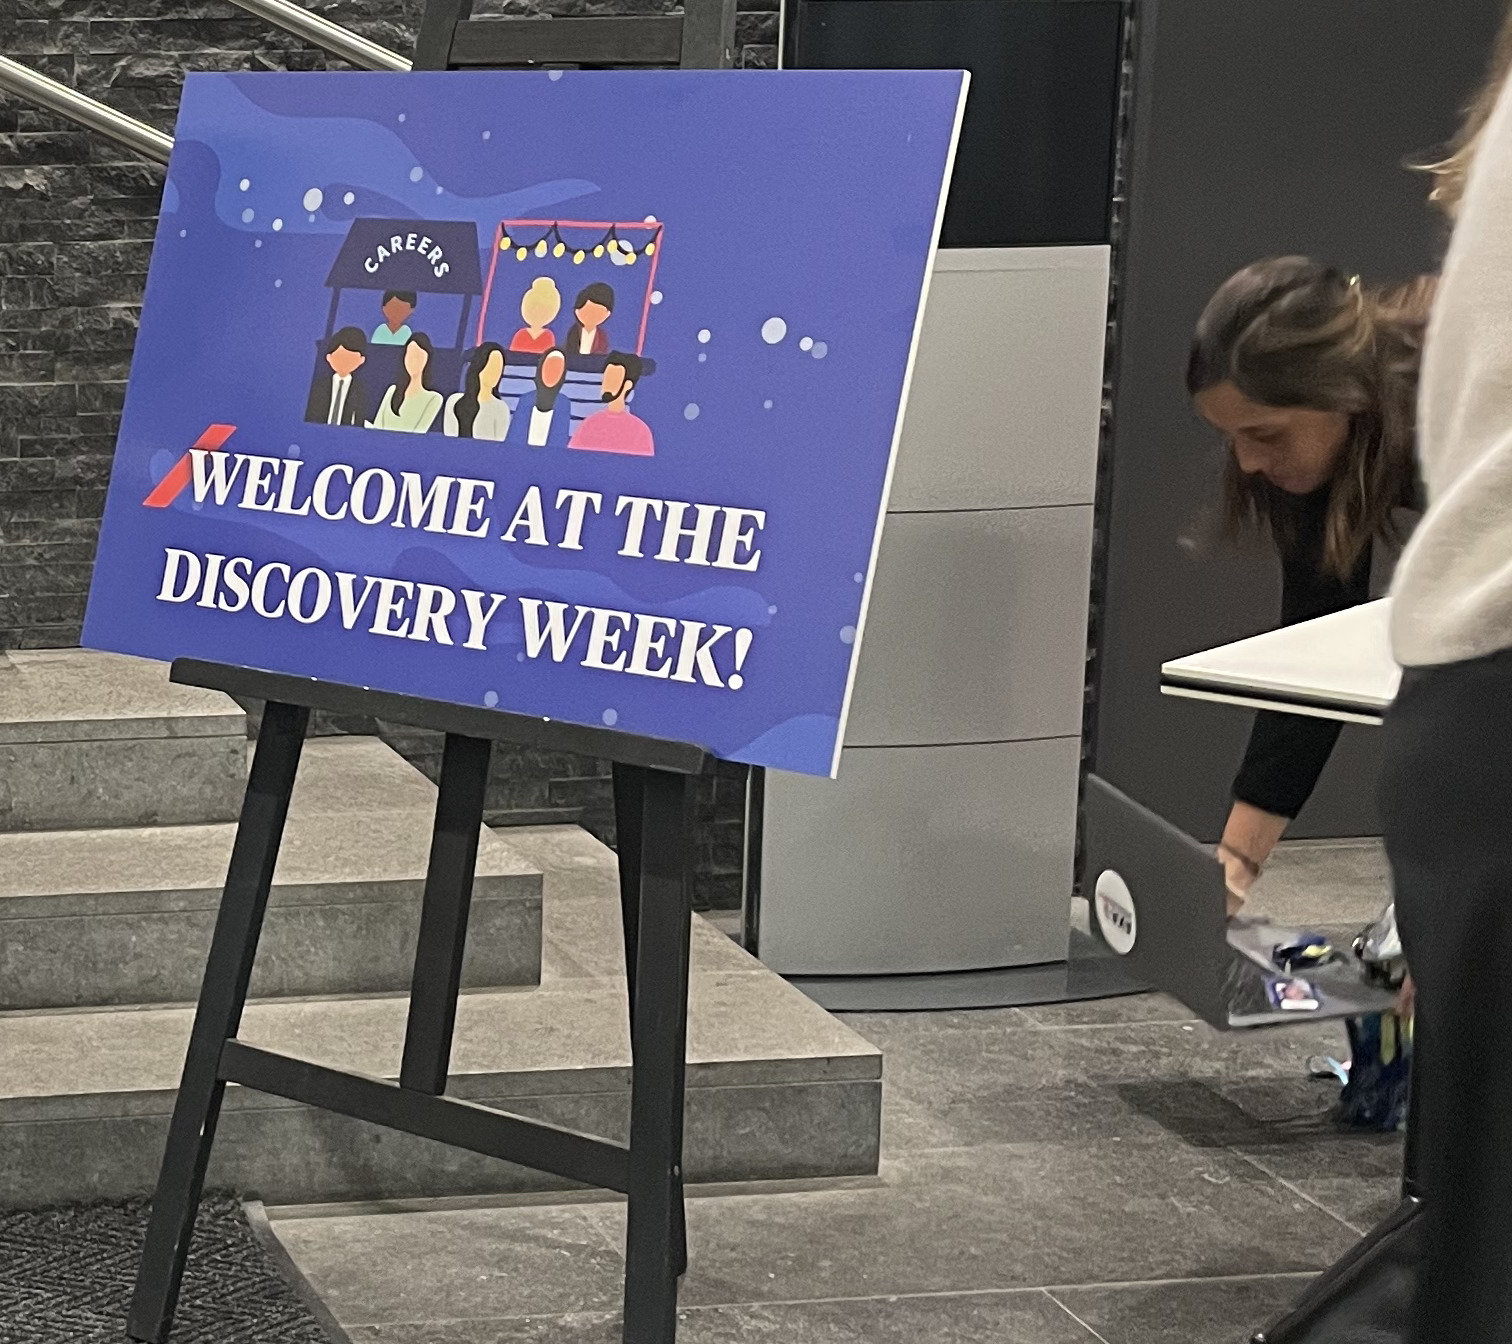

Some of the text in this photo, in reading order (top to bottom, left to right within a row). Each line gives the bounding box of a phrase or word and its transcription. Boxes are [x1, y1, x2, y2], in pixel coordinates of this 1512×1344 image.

[364, 232, 450, 278] CAREERS
[188, 448, 767, 573] WELCOME AT THE
[155, 547, 755, 691] DISCOVERY WEEK!
